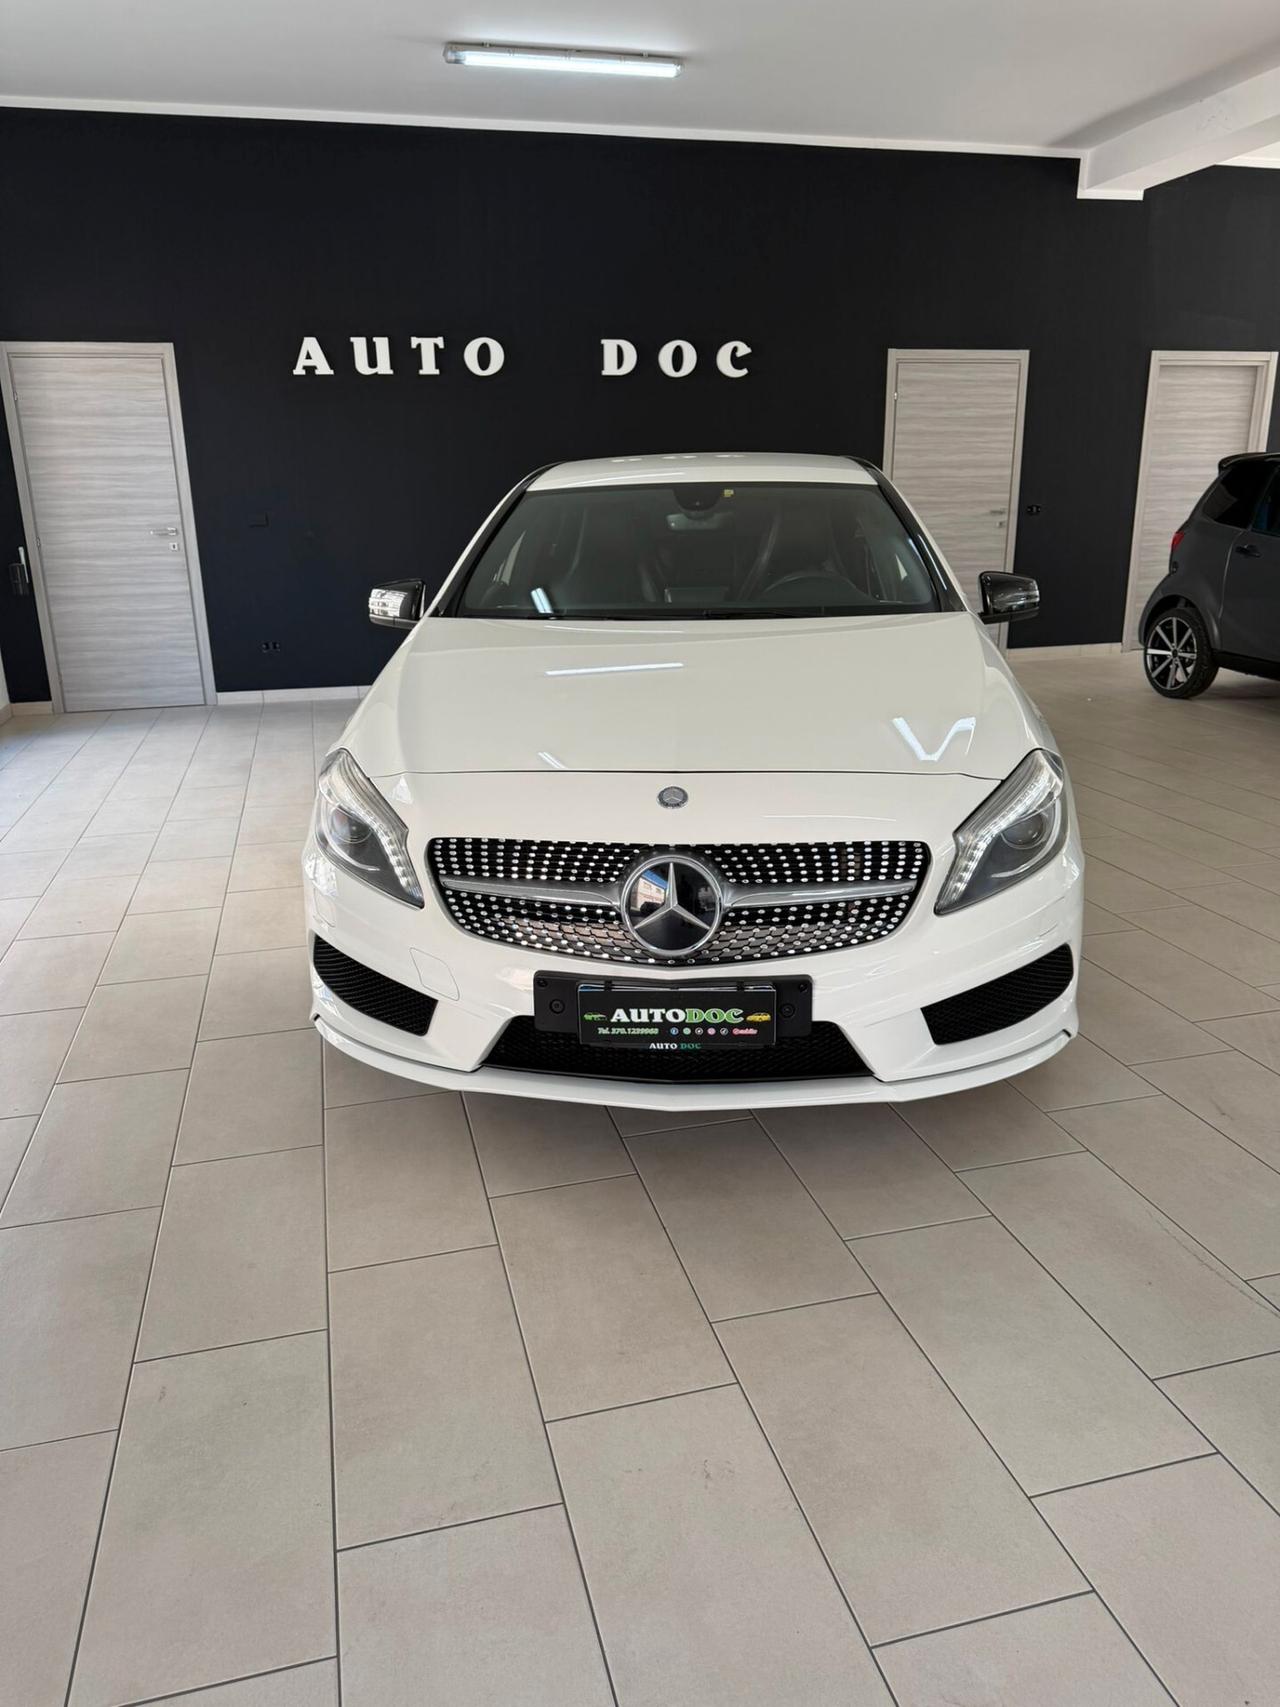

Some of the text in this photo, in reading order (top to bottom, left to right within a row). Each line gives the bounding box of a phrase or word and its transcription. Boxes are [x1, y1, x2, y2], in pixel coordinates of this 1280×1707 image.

[293, 336, 752, 378] AUTO DOC
[610, 1008, 744, 1023] AUTODOC
[649, 1042, 702, 1050] AUTO DOC
